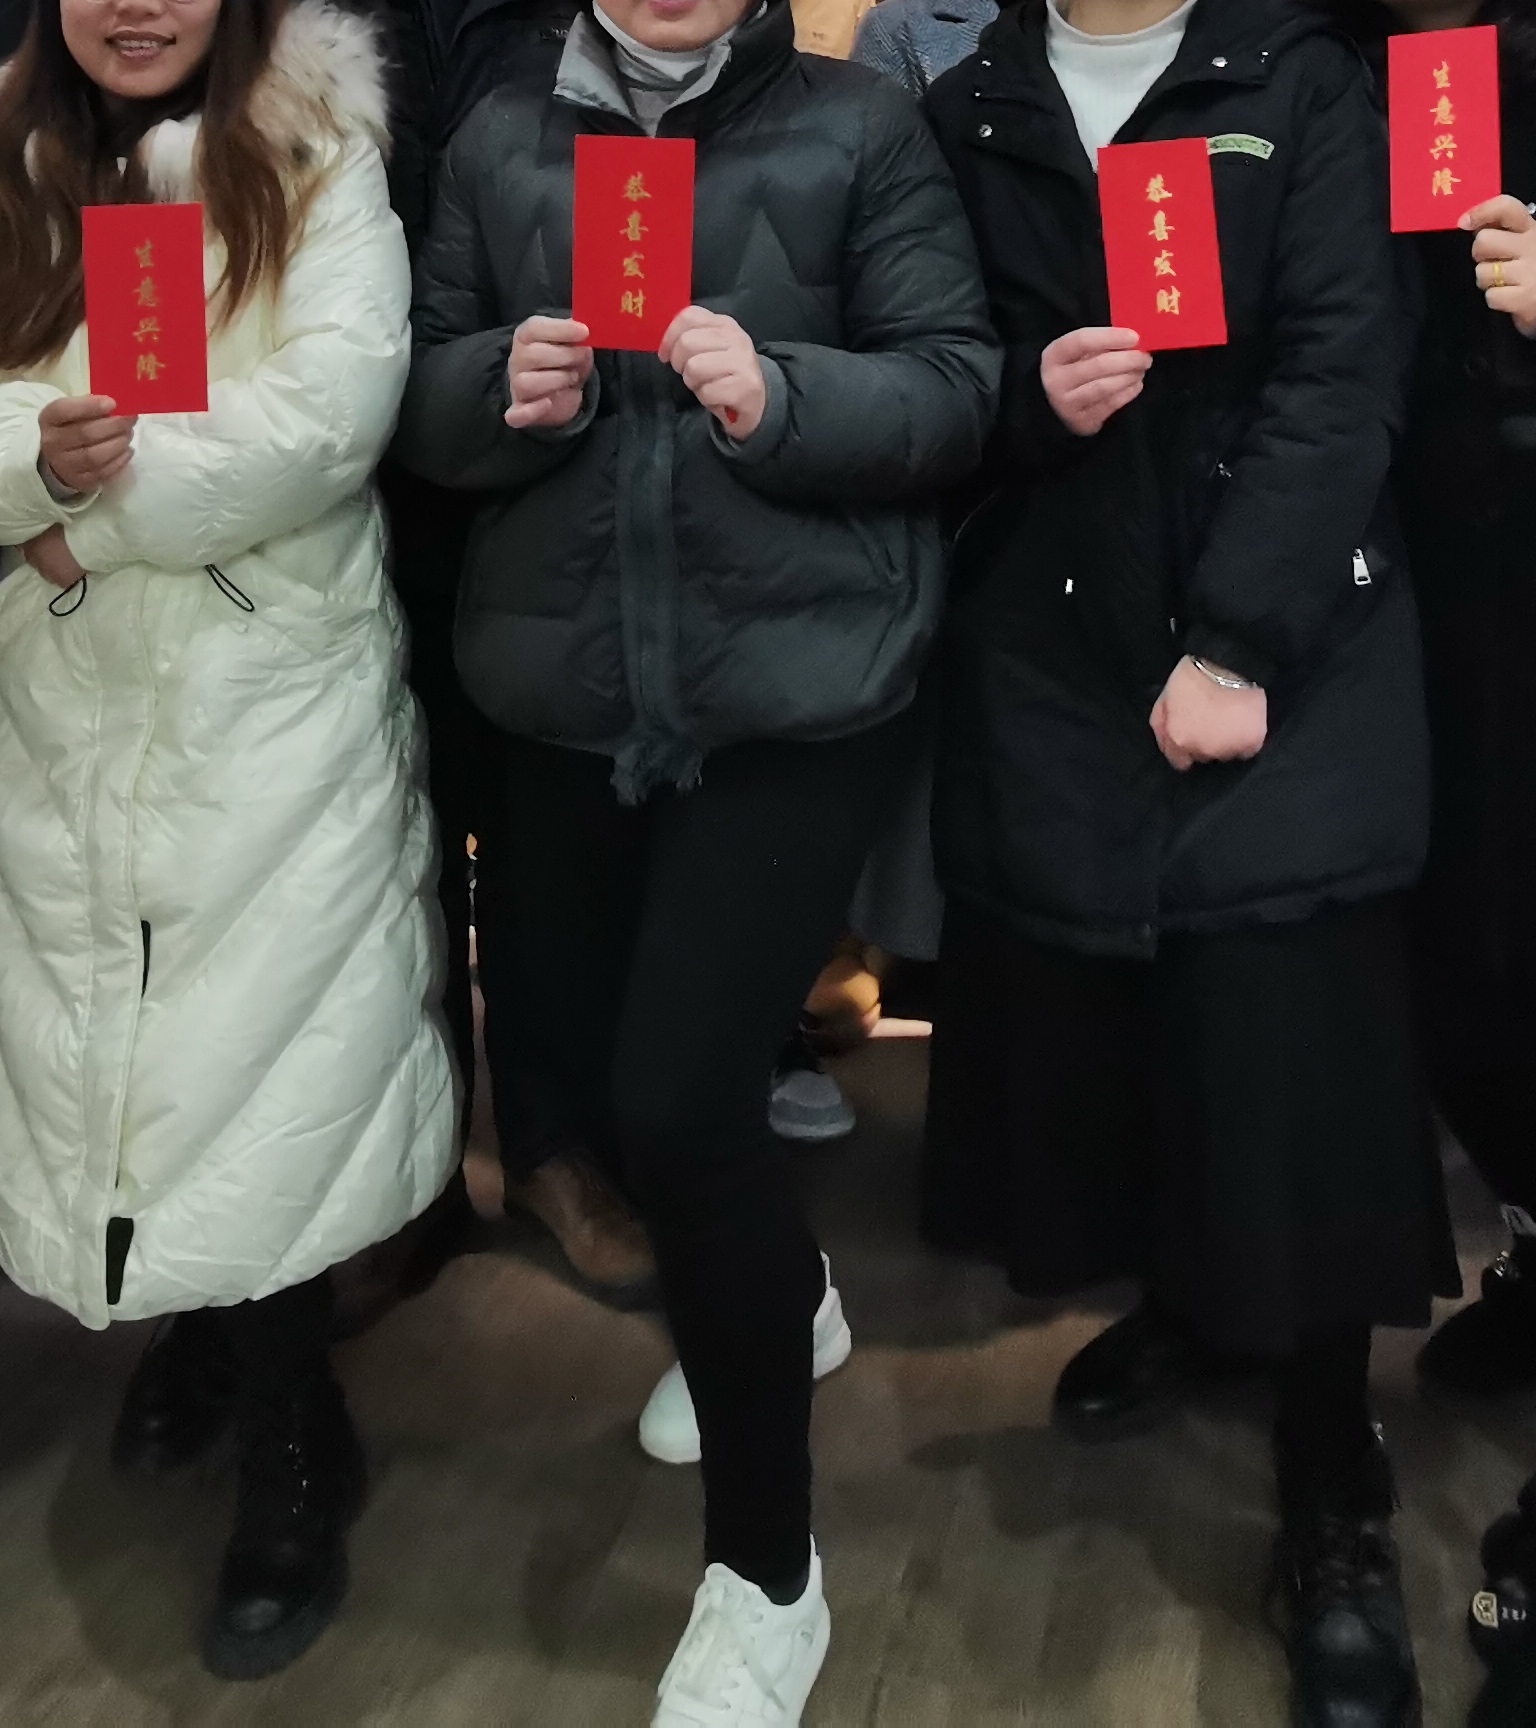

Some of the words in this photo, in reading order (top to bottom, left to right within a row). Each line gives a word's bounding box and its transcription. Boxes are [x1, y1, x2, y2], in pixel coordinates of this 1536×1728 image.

[1429, 60, 1462, 196] 生意兴隆
[133, 238, 167, 381] 生意兴隆
[621, 171, 653, 319] 恭喜发财
[1146, 174, 1181, 315] 恭喜发财
